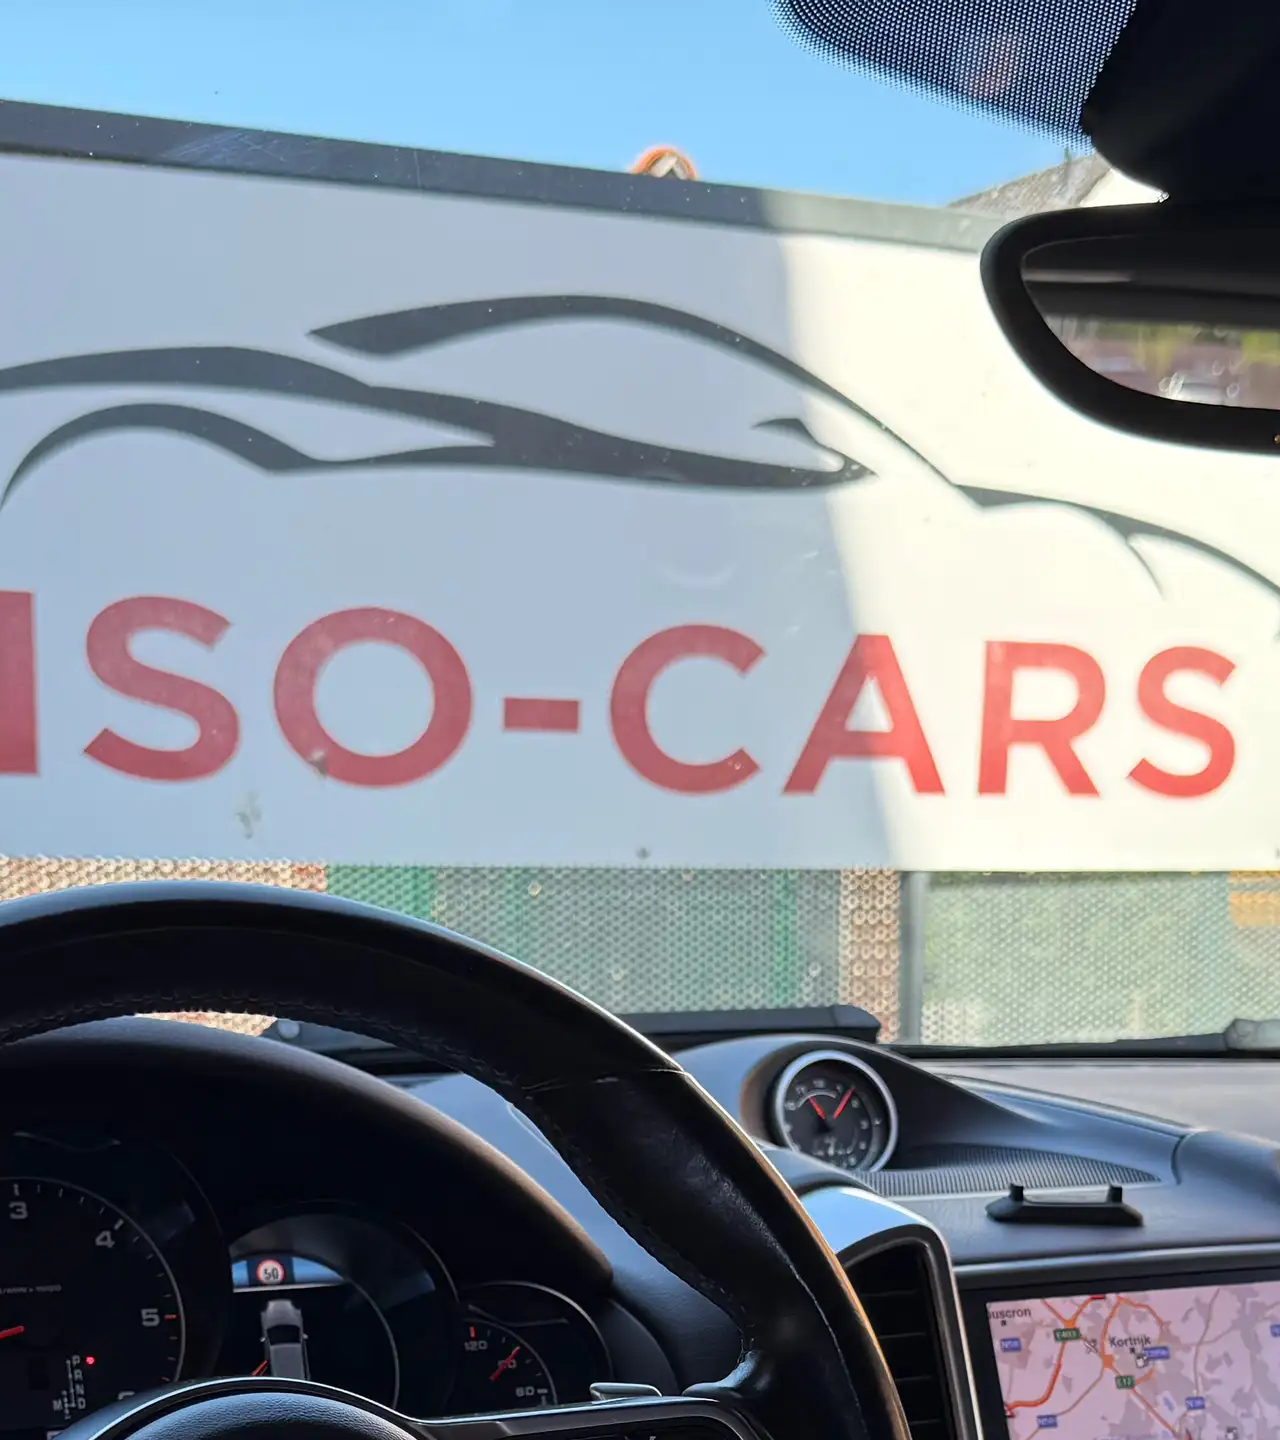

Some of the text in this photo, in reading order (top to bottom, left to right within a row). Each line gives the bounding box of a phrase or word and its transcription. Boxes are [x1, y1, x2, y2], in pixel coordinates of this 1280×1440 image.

[8, 1202, 28, 1219] 3
[94, 1230, 115, 1249] 4
[263, 1266, 279, 1281] 50
[142, 1310, 160, 1326] 5
[464, 1340, 488, 1352] 120
[1108, 1335, 1152, 1348] Kortrijk
[516, 1386, 535, 1398] 60
